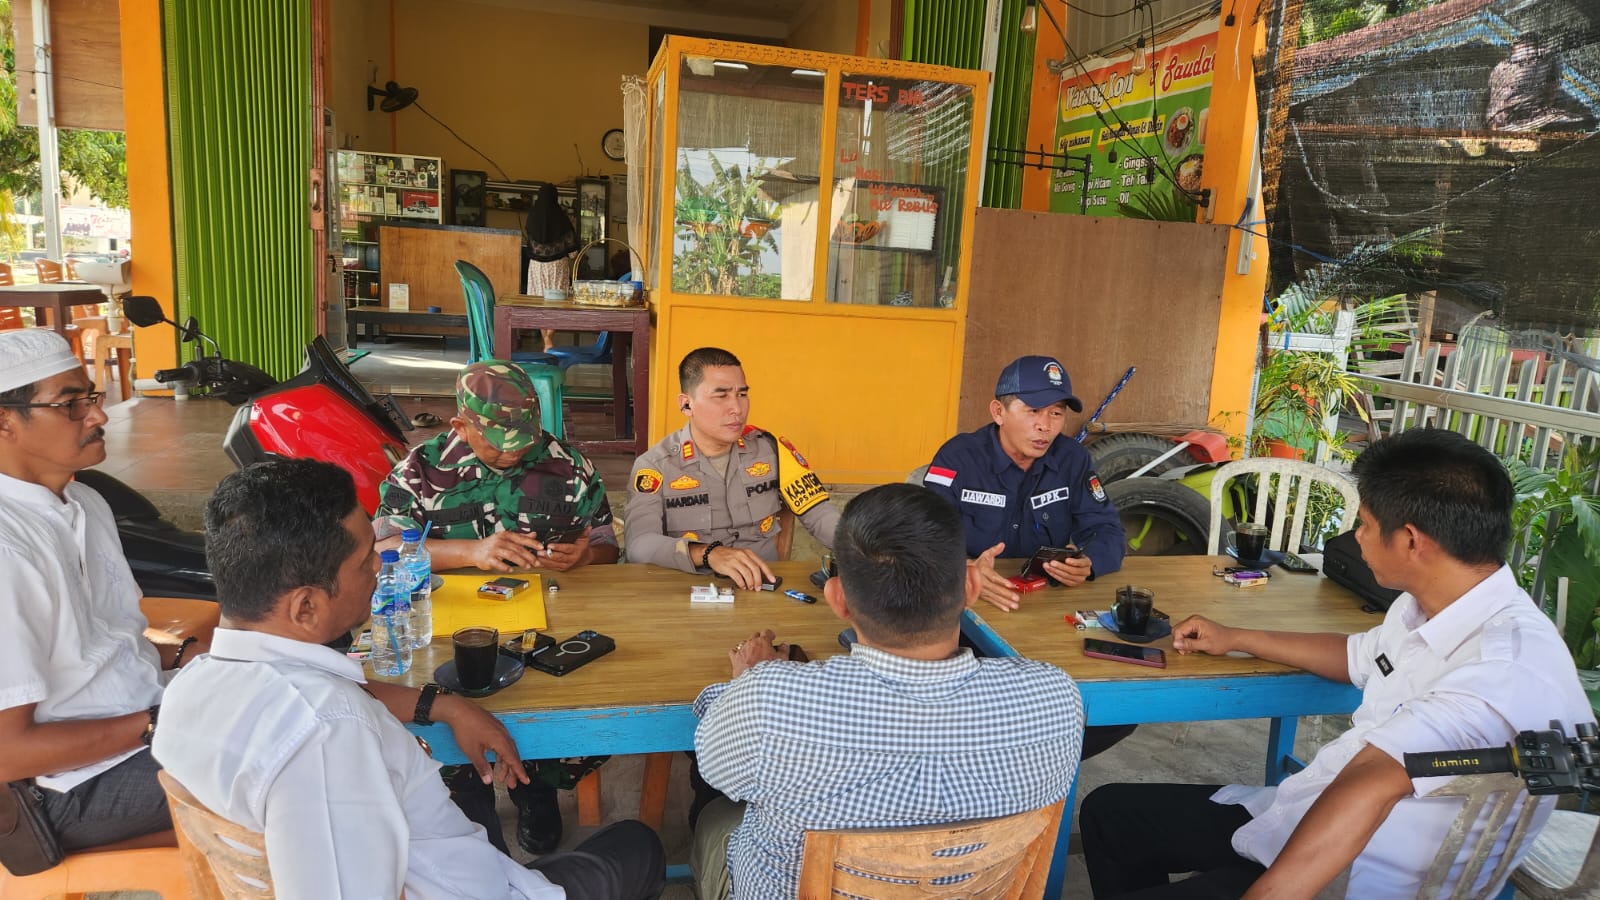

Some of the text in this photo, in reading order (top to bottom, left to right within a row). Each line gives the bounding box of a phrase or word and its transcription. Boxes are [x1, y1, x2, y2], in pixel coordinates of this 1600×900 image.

[794, 495, 809, 508] OPS
[964, 490, 1005, 507] JAWARDI
[1041, 490, 1060, 504] PPK
